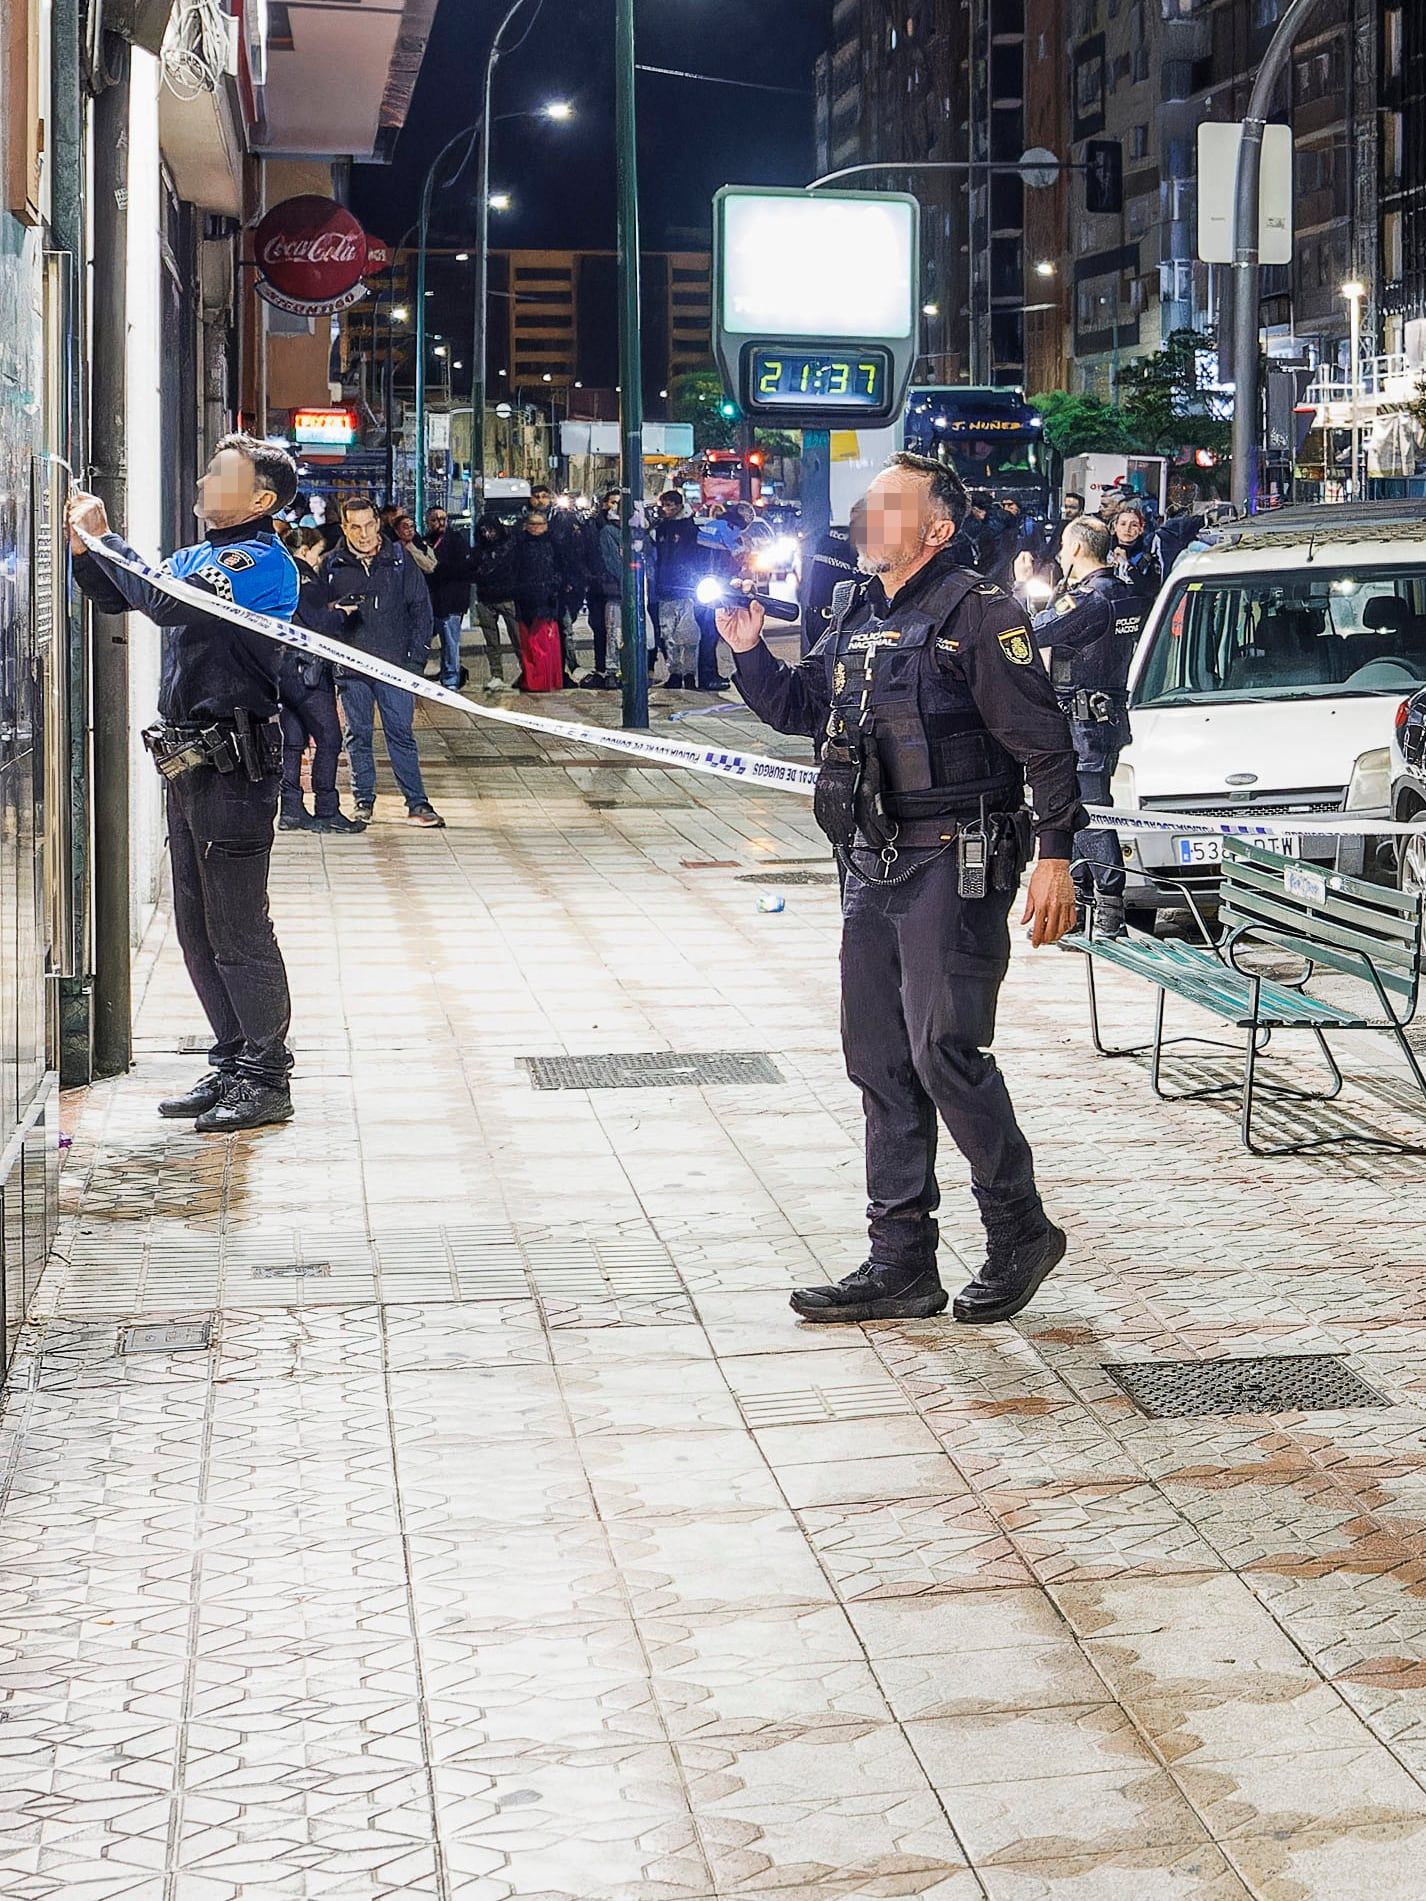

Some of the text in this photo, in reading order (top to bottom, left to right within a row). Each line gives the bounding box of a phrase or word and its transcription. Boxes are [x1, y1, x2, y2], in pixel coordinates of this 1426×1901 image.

[760, 361, 876, 394] 21:37
[752, 763, 819, 785] OCAL DE BURGOS
